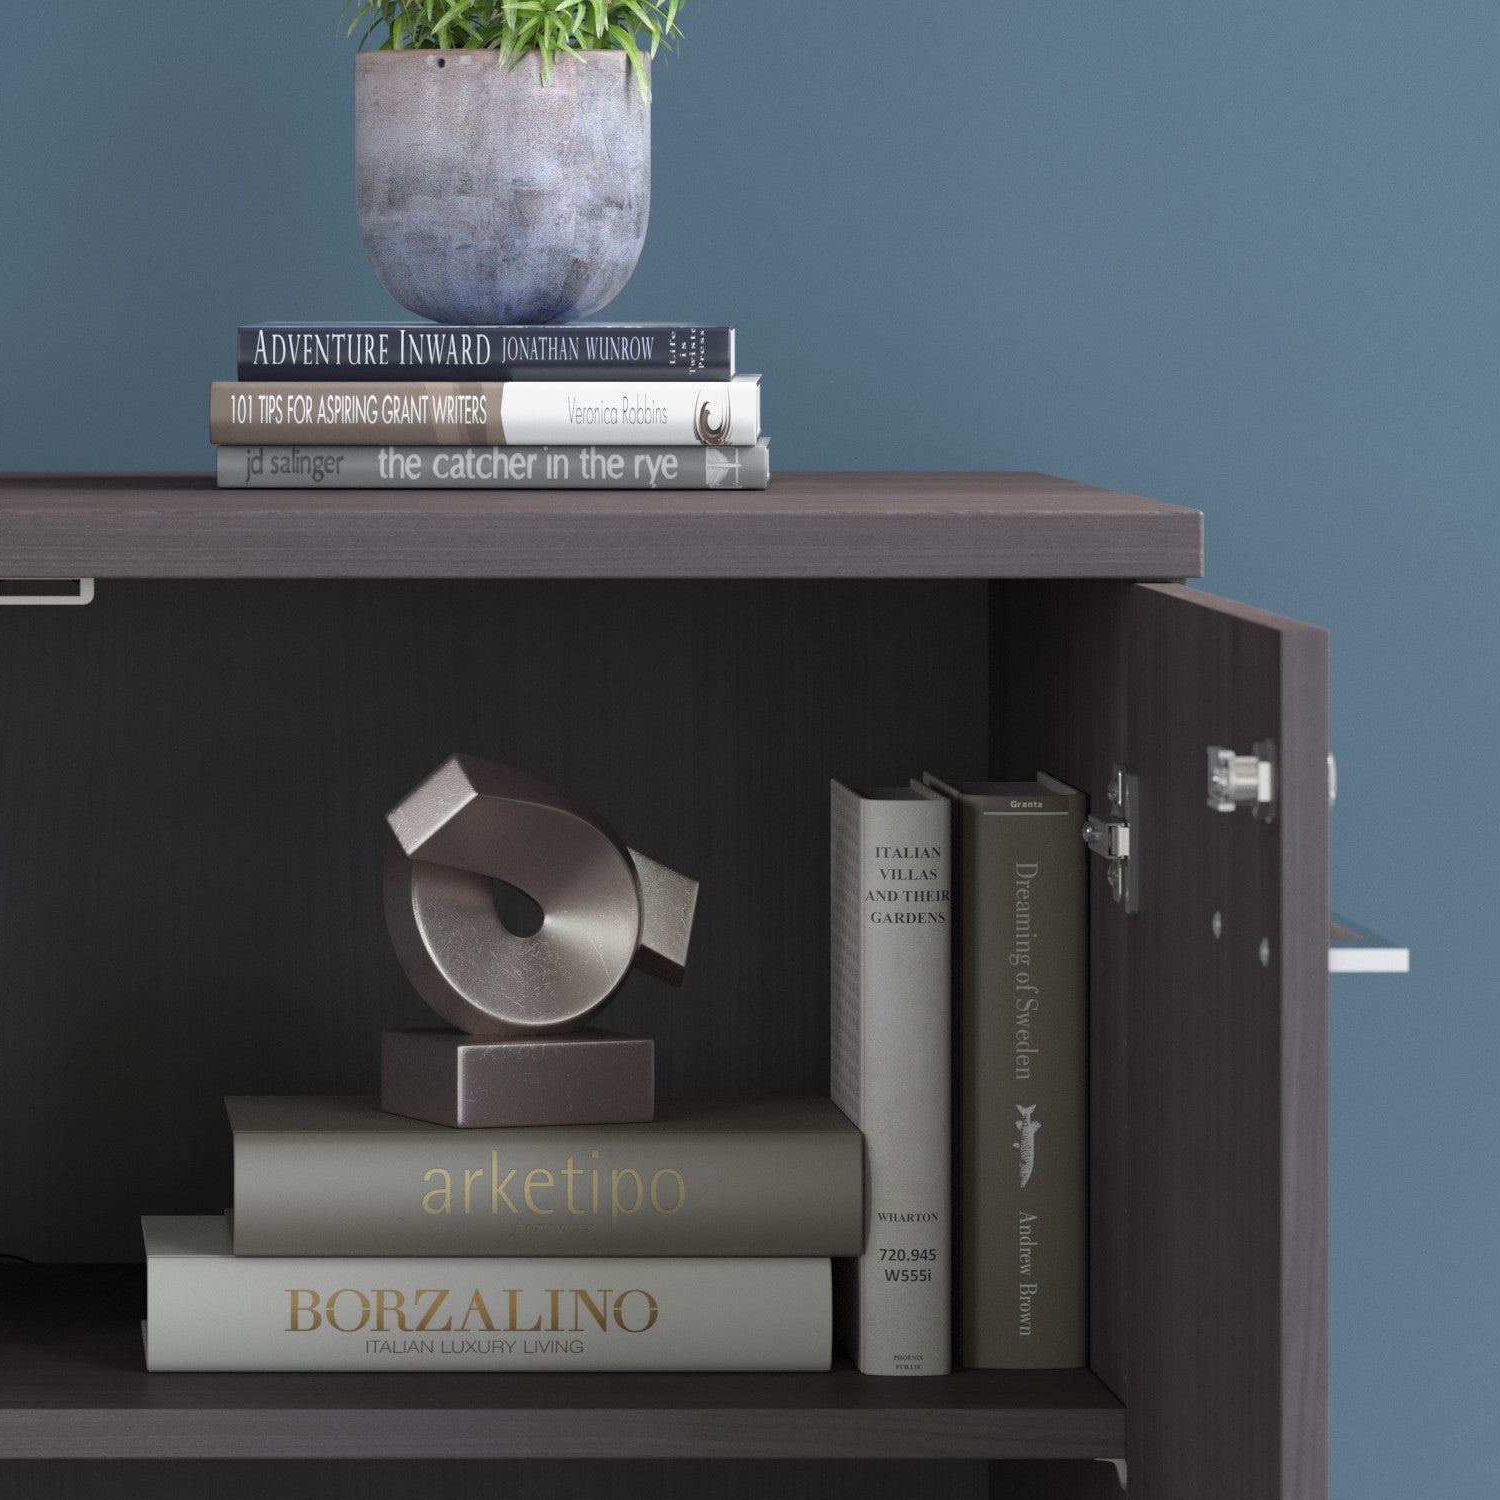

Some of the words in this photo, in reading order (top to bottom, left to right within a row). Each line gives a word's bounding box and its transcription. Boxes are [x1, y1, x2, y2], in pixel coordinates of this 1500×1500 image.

[253, 329, 389, 365] ADVENTURE
[399, 329, 491, 365] INWARD
[501, 336, 580, 364] JONATHAN
[585, 336, 655, 361] WUNROW
[669, 330, 677, 365] Life
[679, 341, 688, 358] is
[231, 394, 253, 425] 101
[258, 394, 284, 425] TIPS
[287, 394, 314, 425] FOR
[316, 394, 379, 425] ASPIRING
[381, 394, 429, 425] GRANT
[432, 394, 488, 425] WRITERS
[567, 395, 619, 425] Veronica
[622, 394, 668, 425] Robbins
[244, 447, 264, 485] jd
[269, 446, 345, 482] salinger
[377, 445, 422, 480] the
[432, 445, 538, 480] catcher
[544, 445, 570, 480] in
[579, 445, 625, 481] the
[633, 453, 679, 488] rye
[1009, 800, 1043, 809] Granta
[874, 846, 942, 859] ITALIAN
[879, 868, 938, 881] VILLAS
[865, 890, 899, 902] AND
[902, 890, 951, 902] THEIR
[870, 912, 946, 924] GARDENS
[1008, 861, 1039, 966] Dreaming
[1015, 971, 1039, 994] of
[1015, 998, 1039, 1082] Sweden
[420, 1149, 687, 1232] arketipo
[877, 1212, 940, 1223] WHARTON
[878, 1249, 937, 1262] 720.945
[1019, 1210, 1038, 1277] Andrew
[884, 1269, 932, 1282] W555i
[284, 1288, 660, 1333] BORZALINO
[1019, 1283, 1038, 1337] Brown
[365, 1340, 434, 1354] ITALIAN
[440, 1340, 518, 1354] LUXURY
[523, 1340, 585, 1354] LIVING
